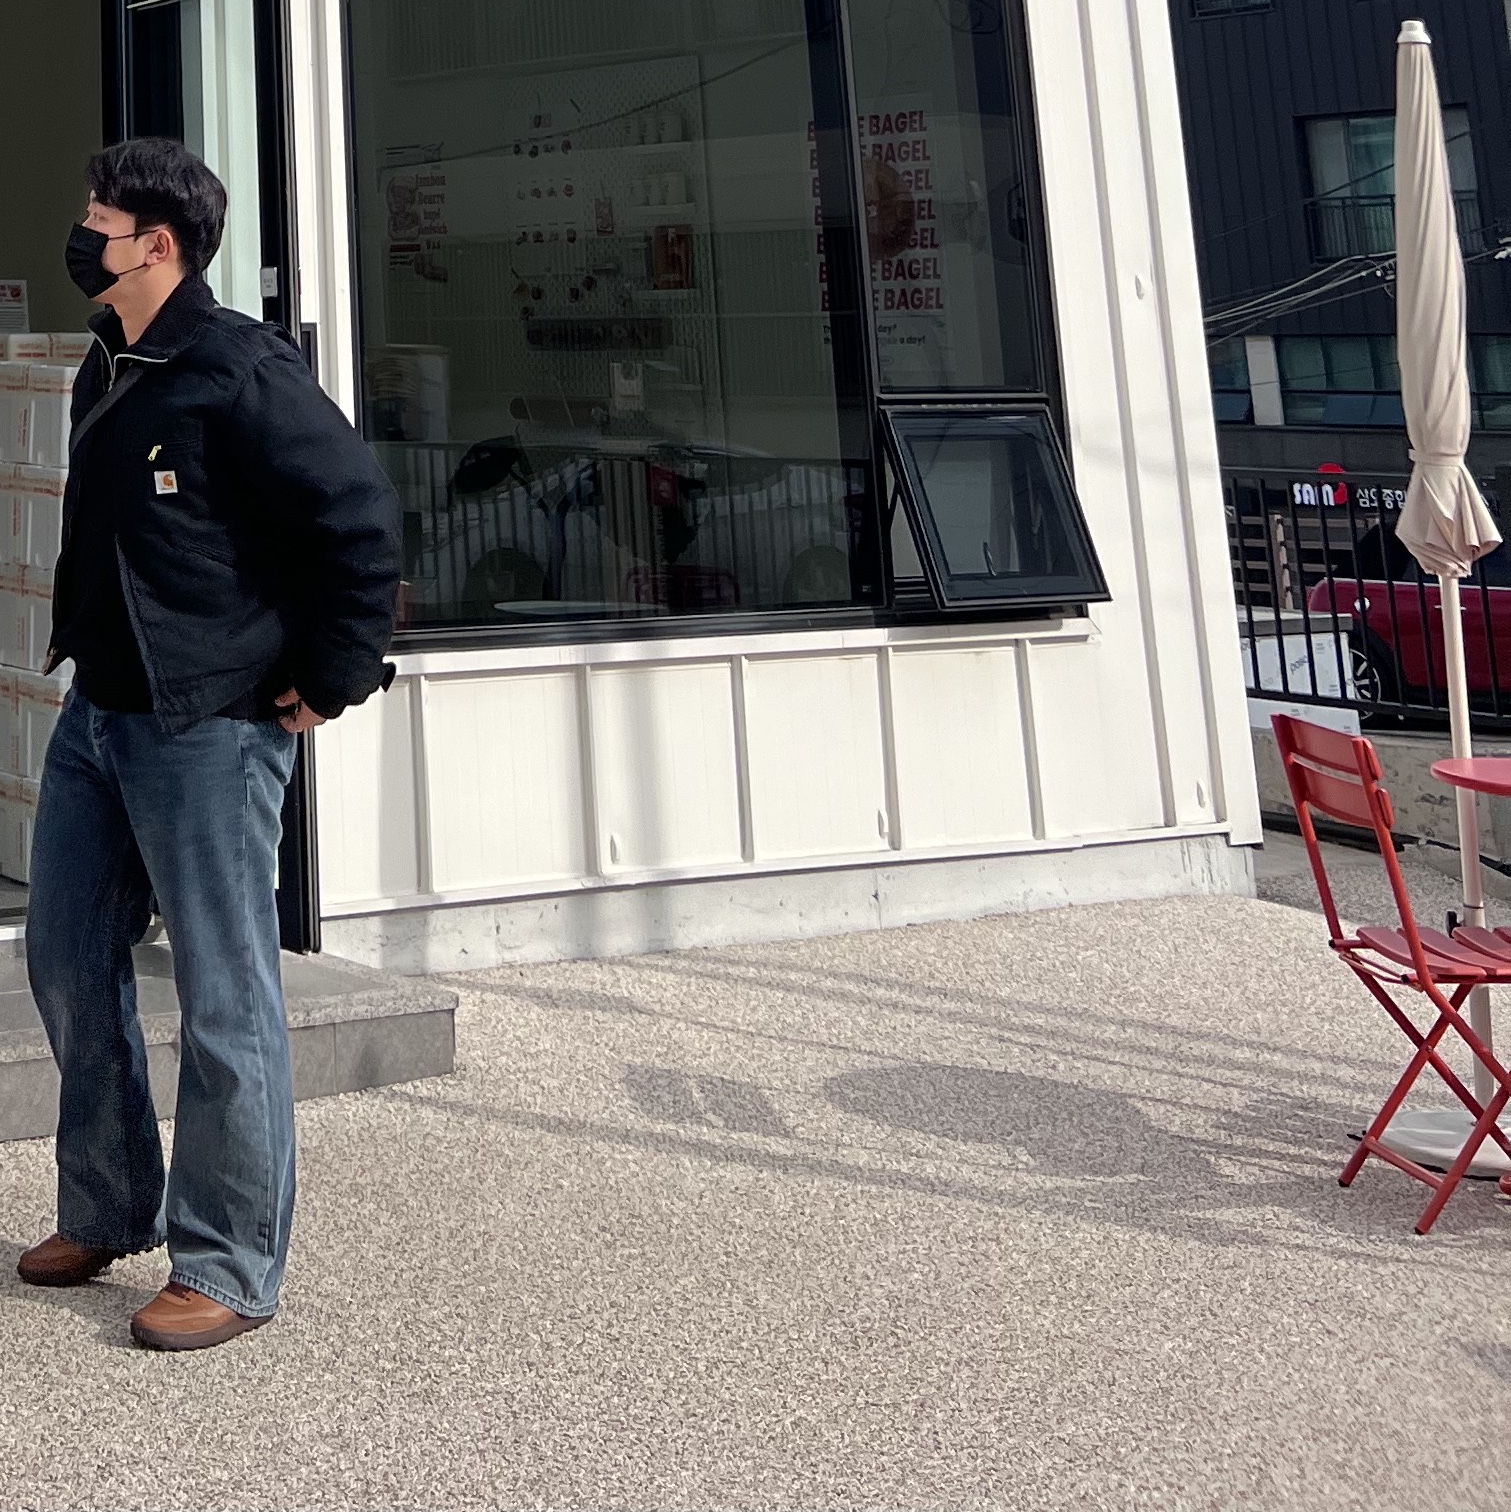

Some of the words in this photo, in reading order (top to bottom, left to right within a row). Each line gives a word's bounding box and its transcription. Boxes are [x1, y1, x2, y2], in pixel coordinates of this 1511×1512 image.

[869, 110, 928, 136] BAGEL
[871, 139, 931, 163] BAGEL
[881, 258, 941, 281] BAGEL
[883, 287, 944, 310] BAGEL
